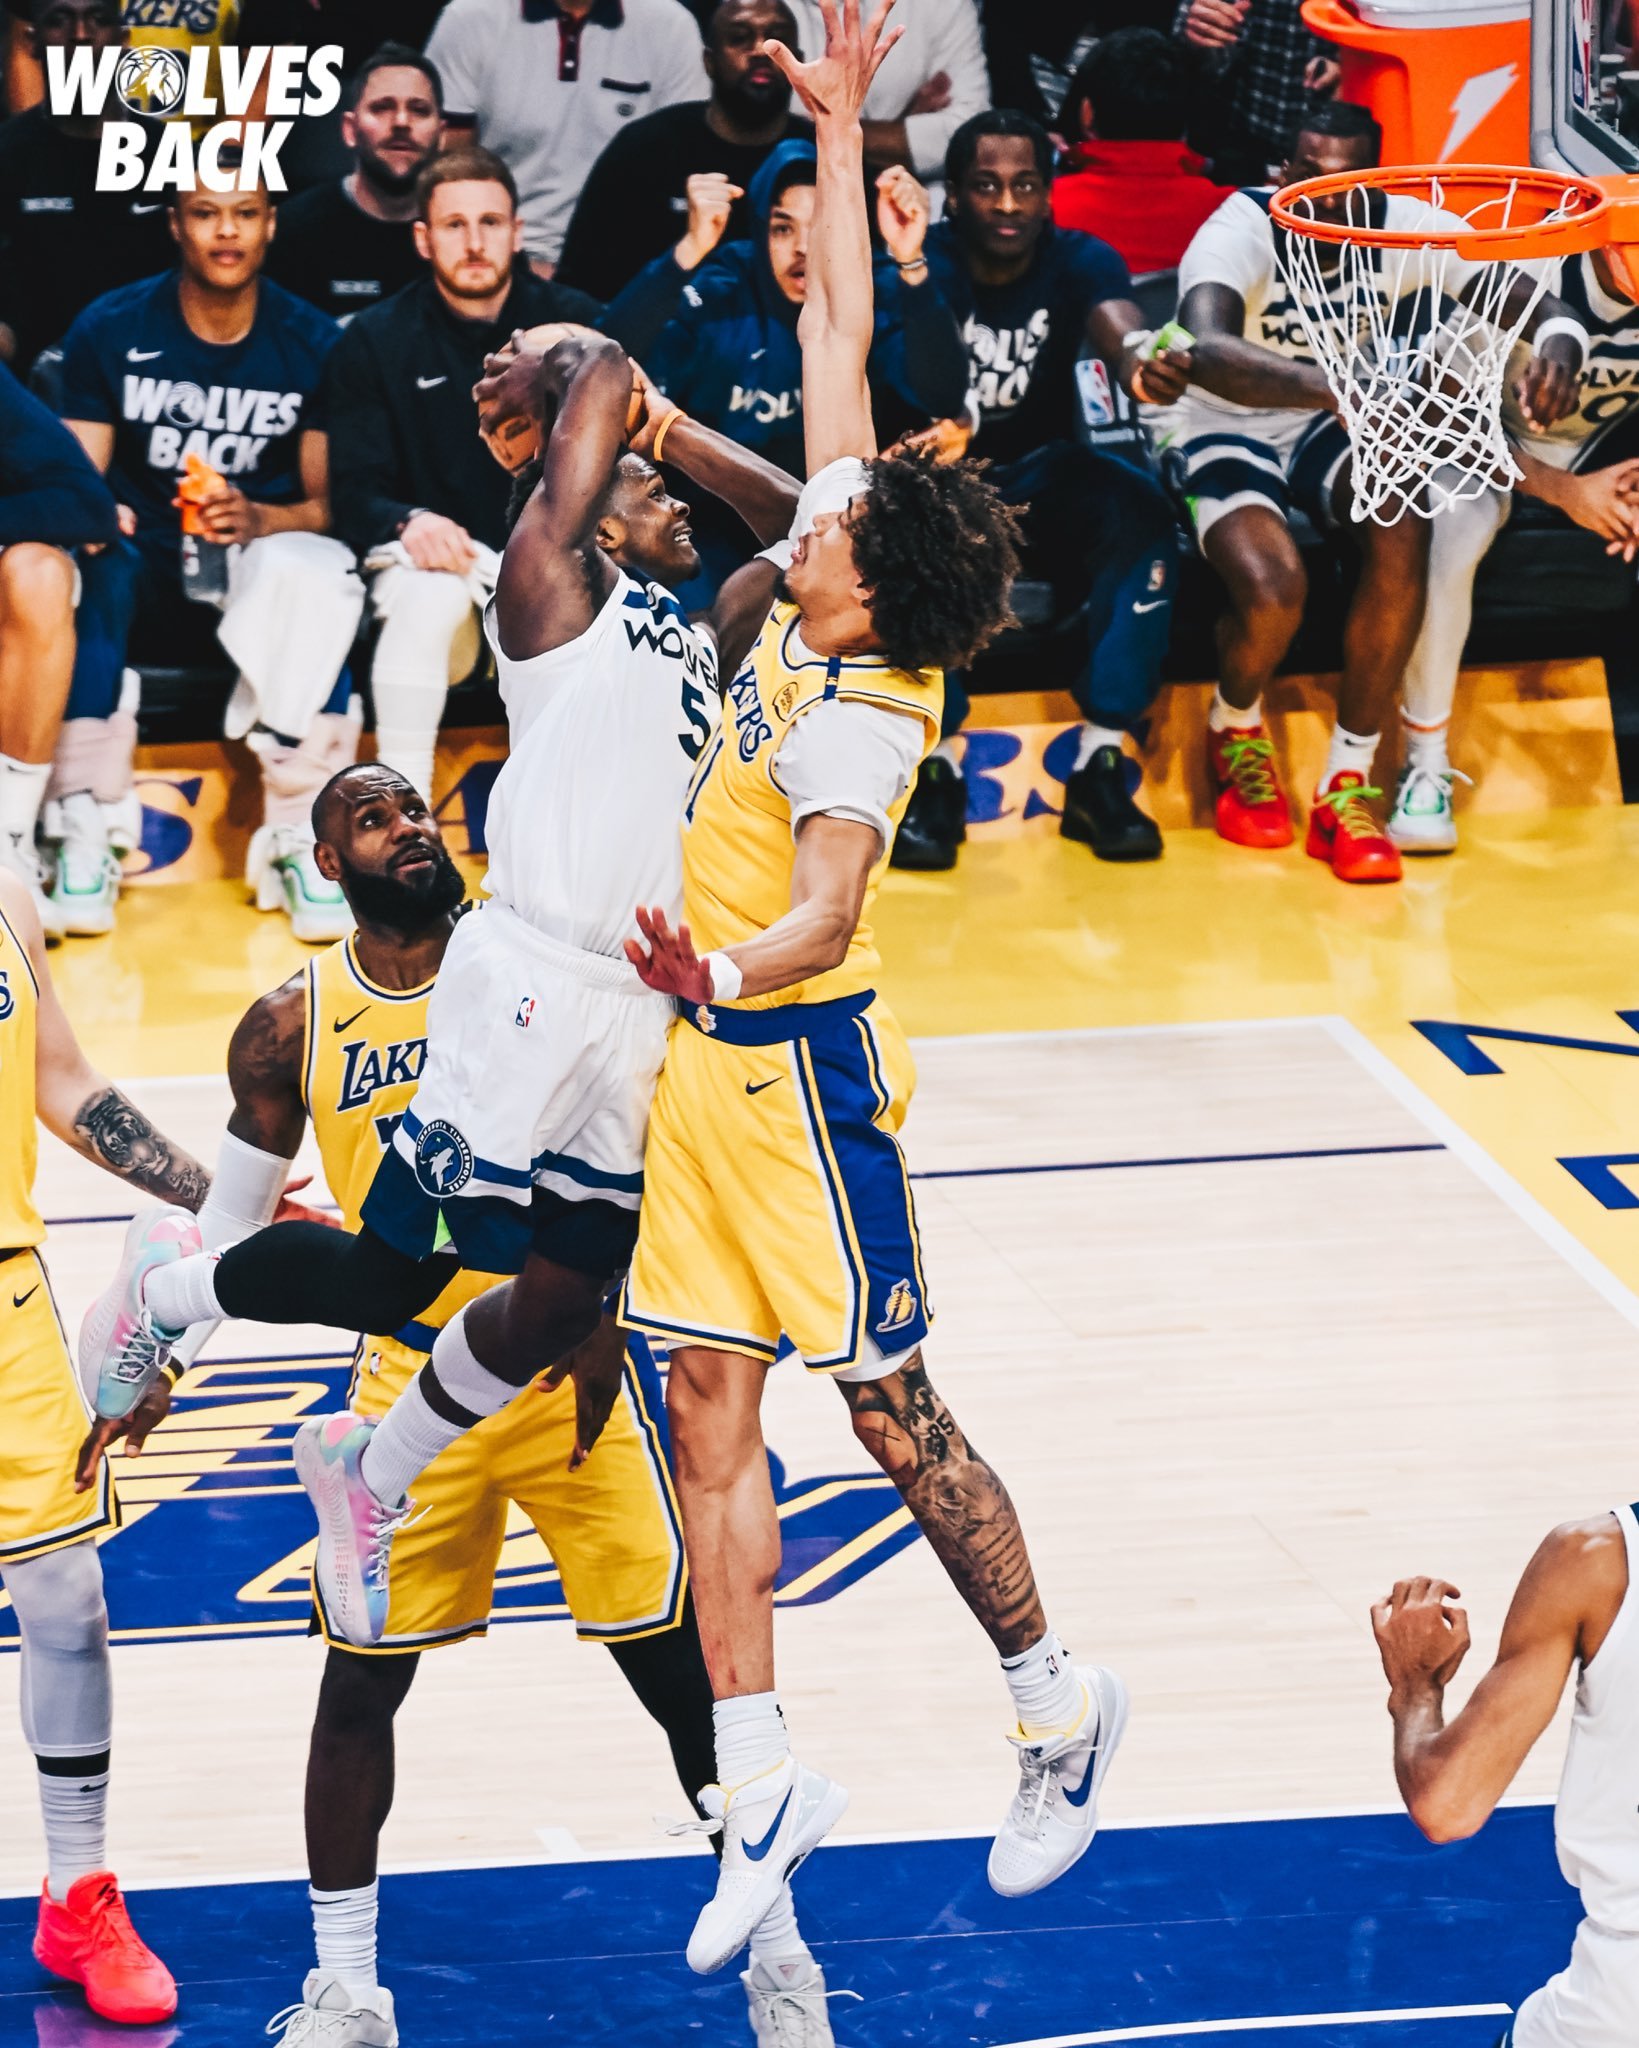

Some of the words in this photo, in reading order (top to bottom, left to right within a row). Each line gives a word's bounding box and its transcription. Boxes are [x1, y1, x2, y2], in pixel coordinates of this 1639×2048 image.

[148, 425, 269, 474] BACK
[677, 676, 711, 762] 5
[417, 1121, 447, 1153] MINNESOTA
[448, 1126, 471, 1193] TIMBERWOLVES
